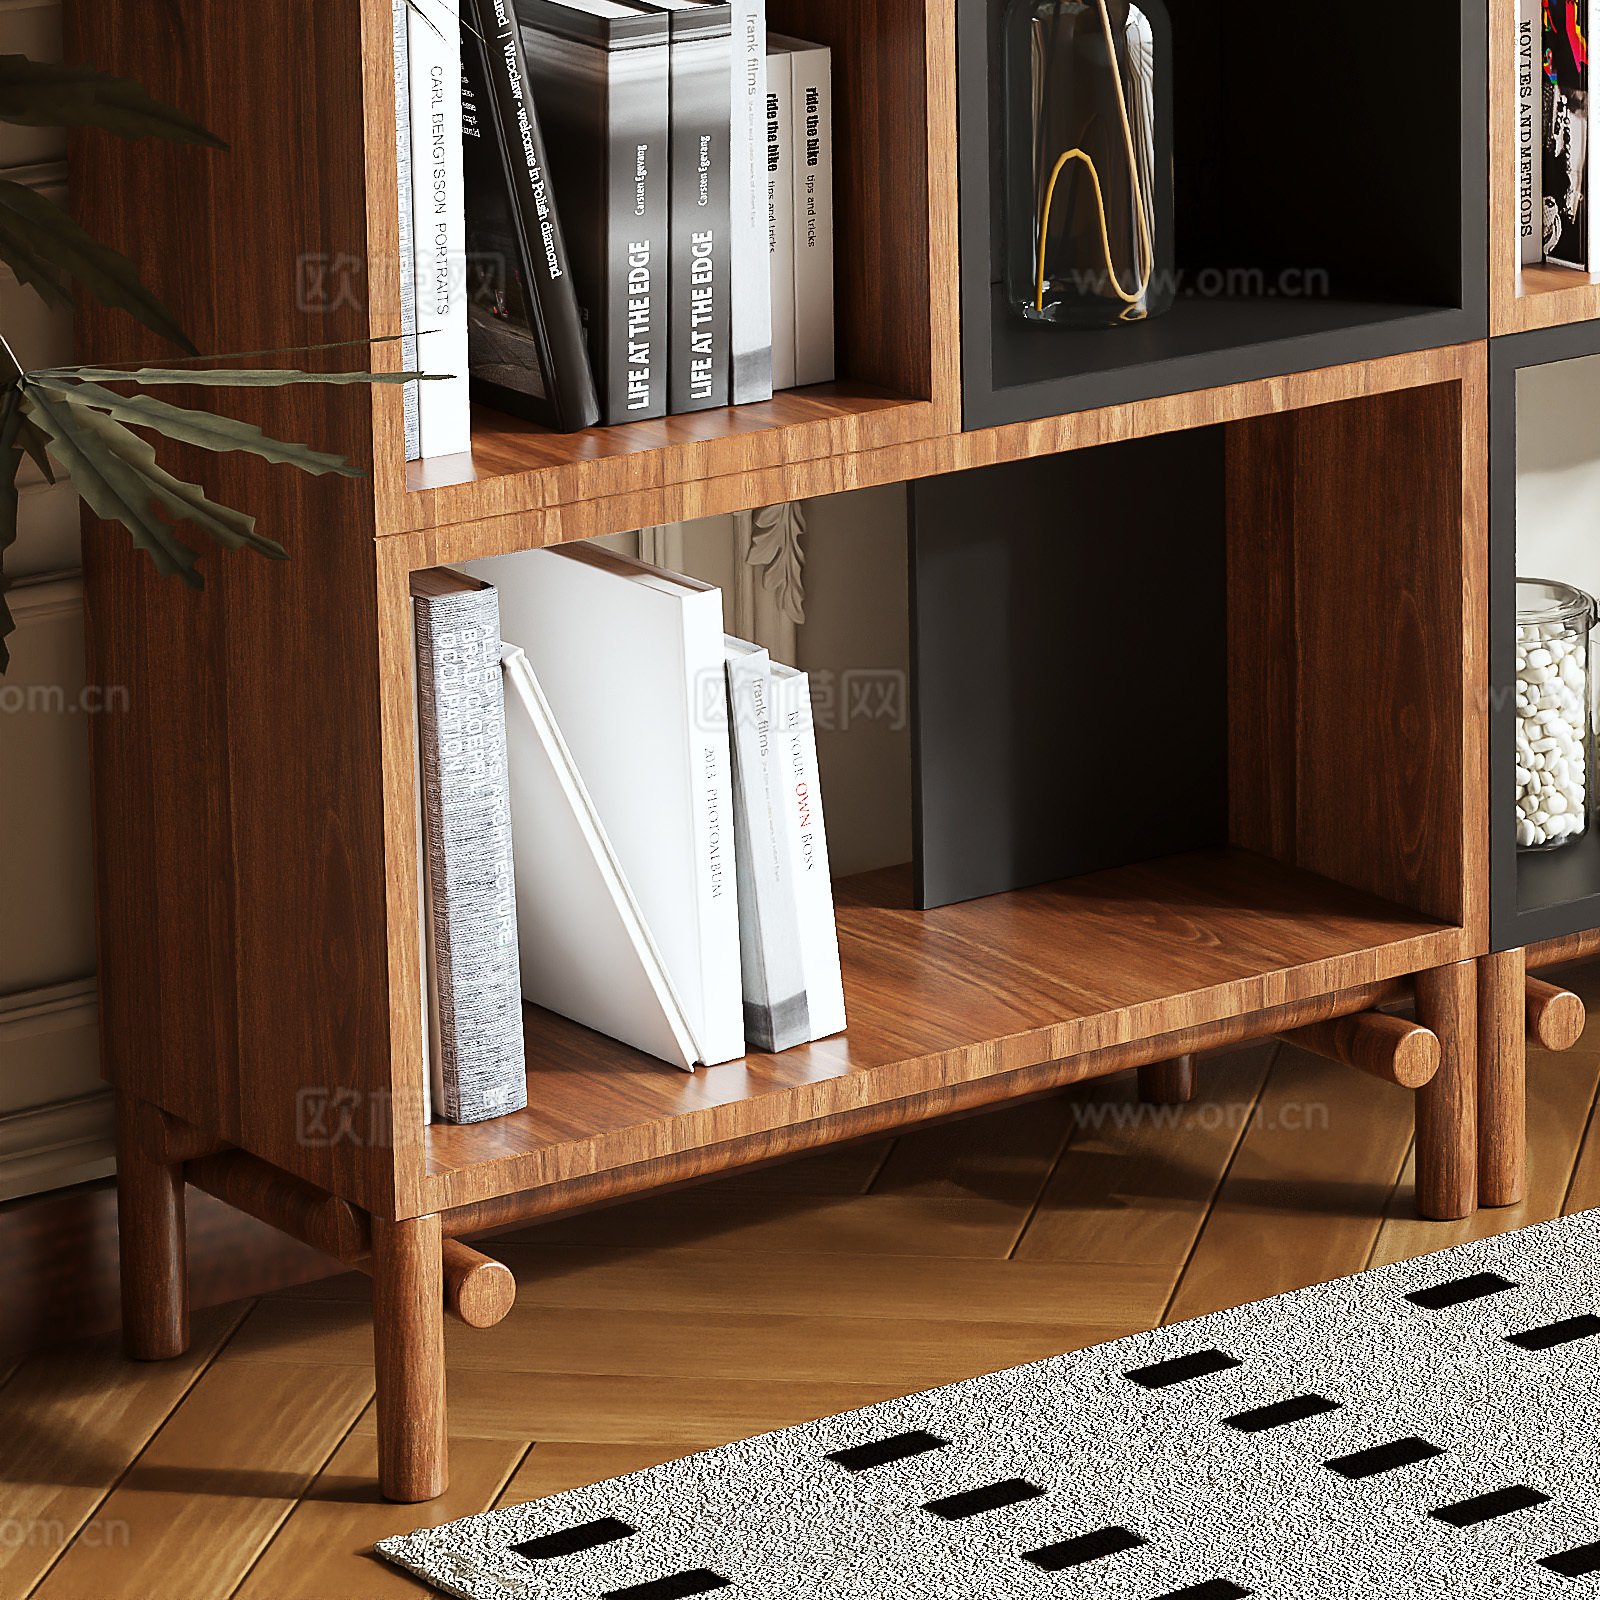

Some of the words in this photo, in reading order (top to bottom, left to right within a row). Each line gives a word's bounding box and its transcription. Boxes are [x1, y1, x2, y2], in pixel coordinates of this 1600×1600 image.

[746, 13, 758, 53] frank
[747, 56, 759, 96] films
[1519, 19, 1532, 98] MOVIES
[430, 65, 443, 109] CARL
[766, 93, 779, 119] ride
[805, 87, 819, 113] ride
[516, 107, 537, 167] welcome
[767, 120, 779, 142] the
[805, 114, 819, 137] the
[1520, 102, 1532, 142] AND
[431, 113, 447, 214] BENGTSSON
[634, 143, 648, 183] Egevang
[698, 135, 711, 172] Egevang
[767, 144, 780, 172] bike
[806, 137, 820, 167] bike
[528, 167, 540, 182] in
[698, 172, 708, 207] Carsten
[805, 174, 816, 194] tips
[1520, 144, 1533, 238] METHODS
[532, 180, 549, 221] Polish
[634, 183, 645, 216] Carsten
[768, 203, 776, 222] and
[807, 196, 817, 216] and
[540, 220, 563, 280] diamond
[807, 218, 817, 248] tricks
[434, 222, 449, 315] PORTRAITS
[628, 239, 650, 295] EDGE
[691, 229, 713, 285] EDGE
[628, 295, 650, 338] THE
[691, 286, 713, 328] THE
[628, 341, 650, 365] AT
[691, 330, 713, 355] AT
[627, 367, 650, 410] LIFE
[690, 356, 713, 400] LIFE
[461, 628, 480, 687] BRAD
[479, 624, 498, 695] ALLIED
[440, 631, 463, 772] OCCUPATION
[752, 677, 767, 717] frank
[466, 692, 485, 796] CLOEPFIL
[486, 699, 502, 777] WORKS
[757, 720, 770, 757] films
[790, 733, 805, 780] YOUR
[795, 782, 811, 828] OWN
[707, 788, 722, 899] PHOTOALBUM
[801, 832, 815, 872] BOSS
[492, 783, 514, 945] ARCHITECTURE
